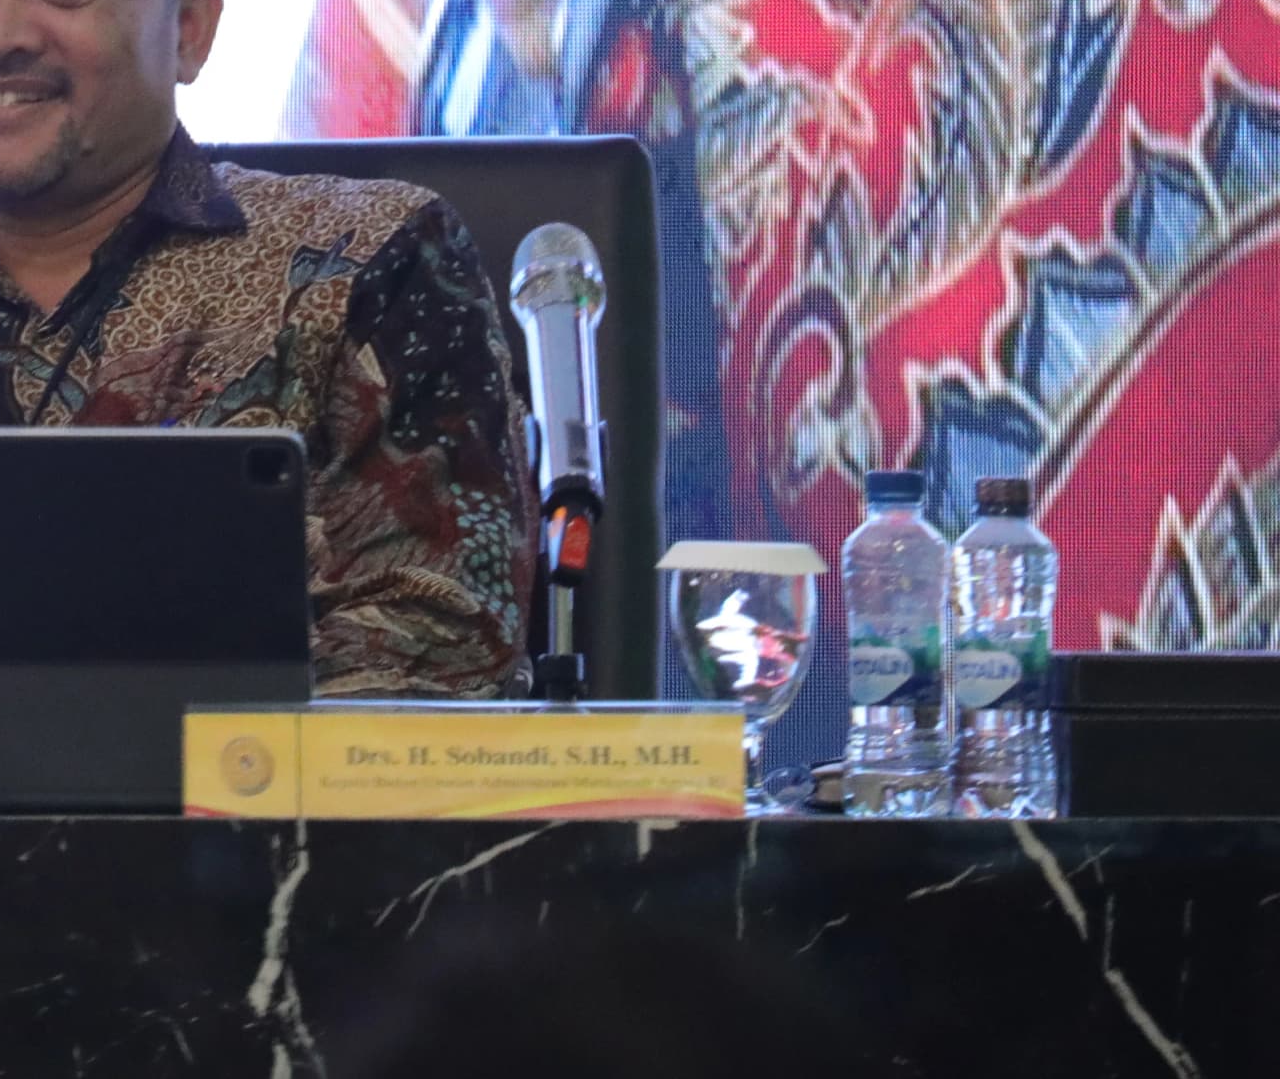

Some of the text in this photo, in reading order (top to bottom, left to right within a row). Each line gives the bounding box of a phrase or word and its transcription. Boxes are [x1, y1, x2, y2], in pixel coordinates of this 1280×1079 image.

[407, 745, 440, 766] H.
[565, 745, 627, 768] S.H.,
[635, 745, 701, 766] M.H.
